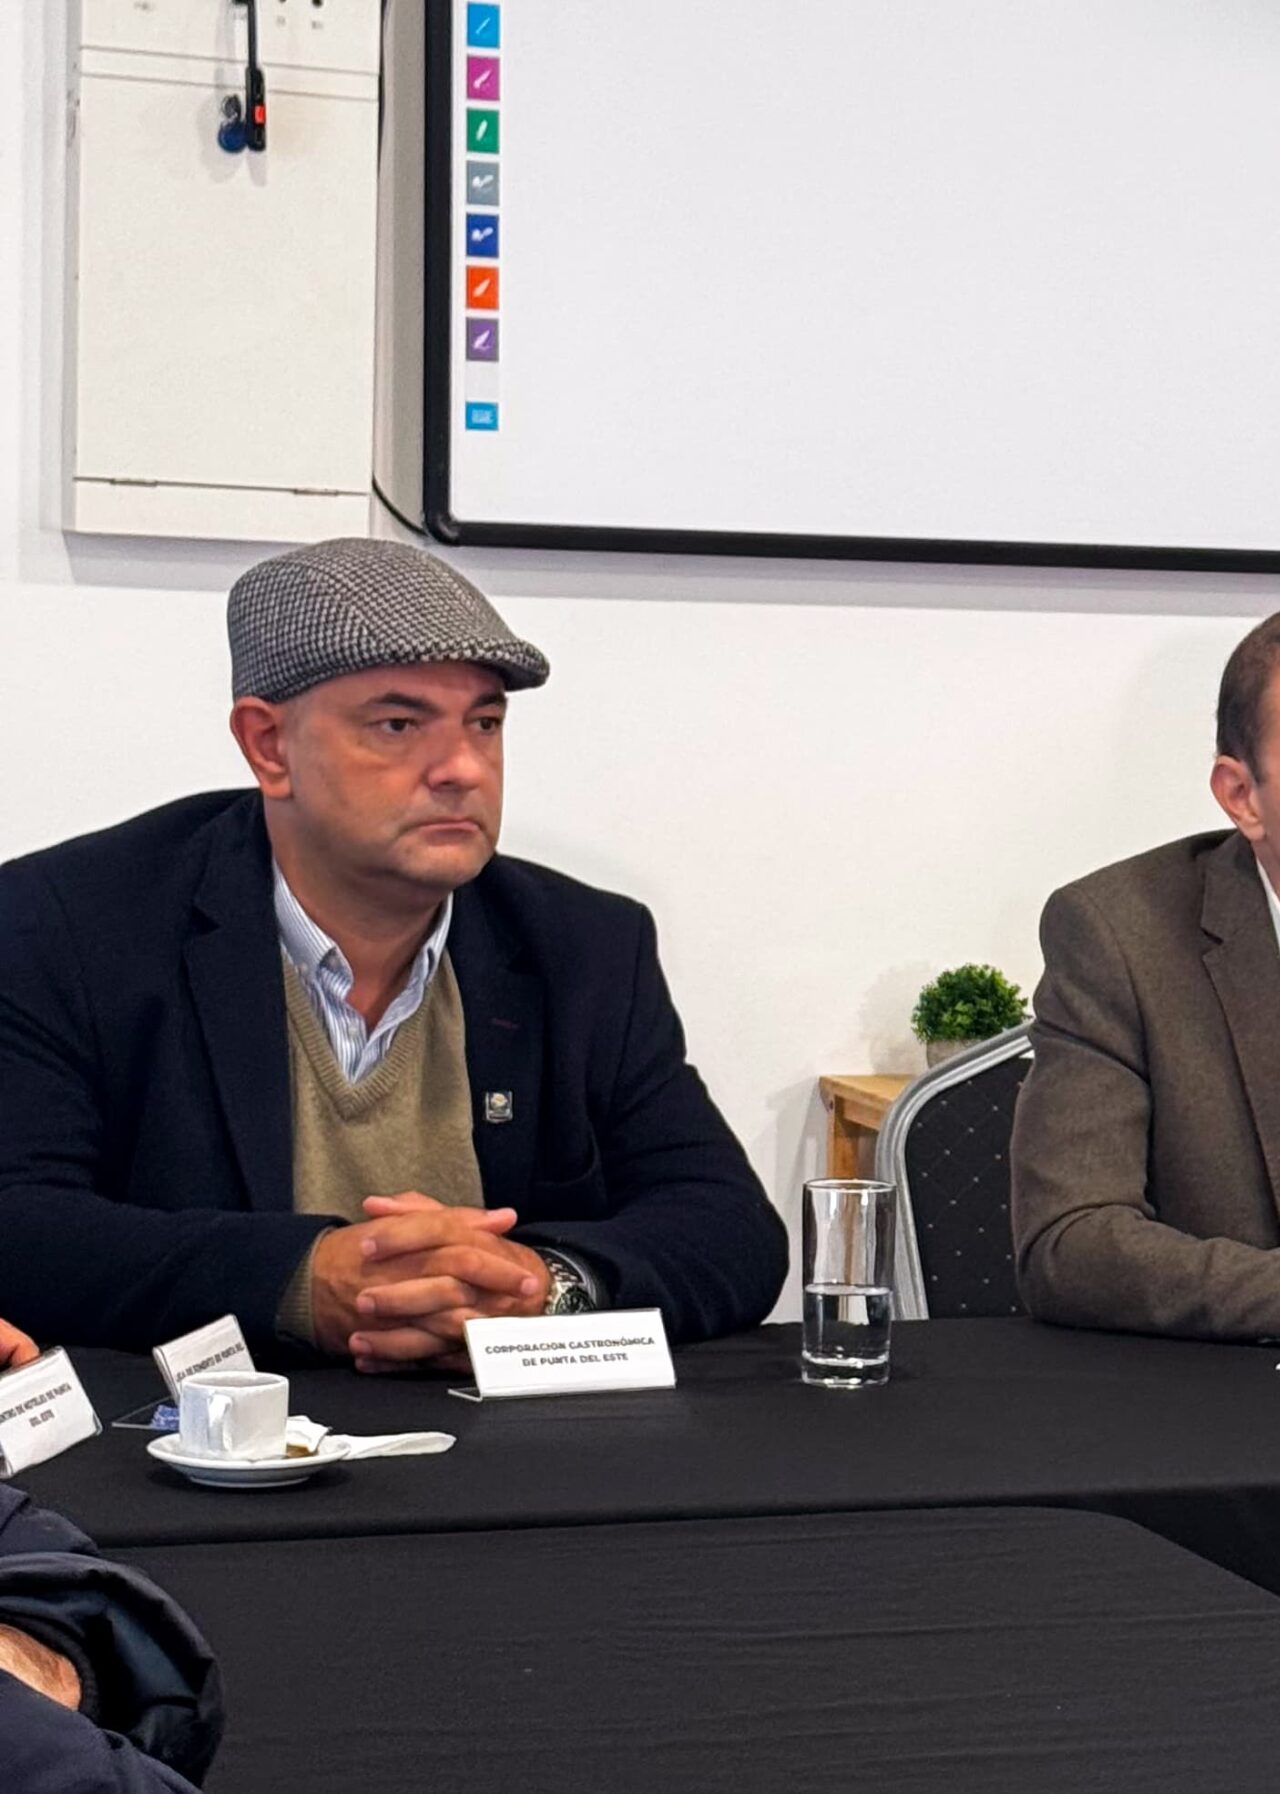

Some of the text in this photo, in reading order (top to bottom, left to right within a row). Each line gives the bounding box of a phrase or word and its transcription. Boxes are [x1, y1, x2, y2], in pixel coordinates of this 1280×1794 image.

[539, 1354, 578, 1366] PUNTA
[579, 1353, 602, 1364] DEL
[603, 1352, 629, 1363] ESTE
